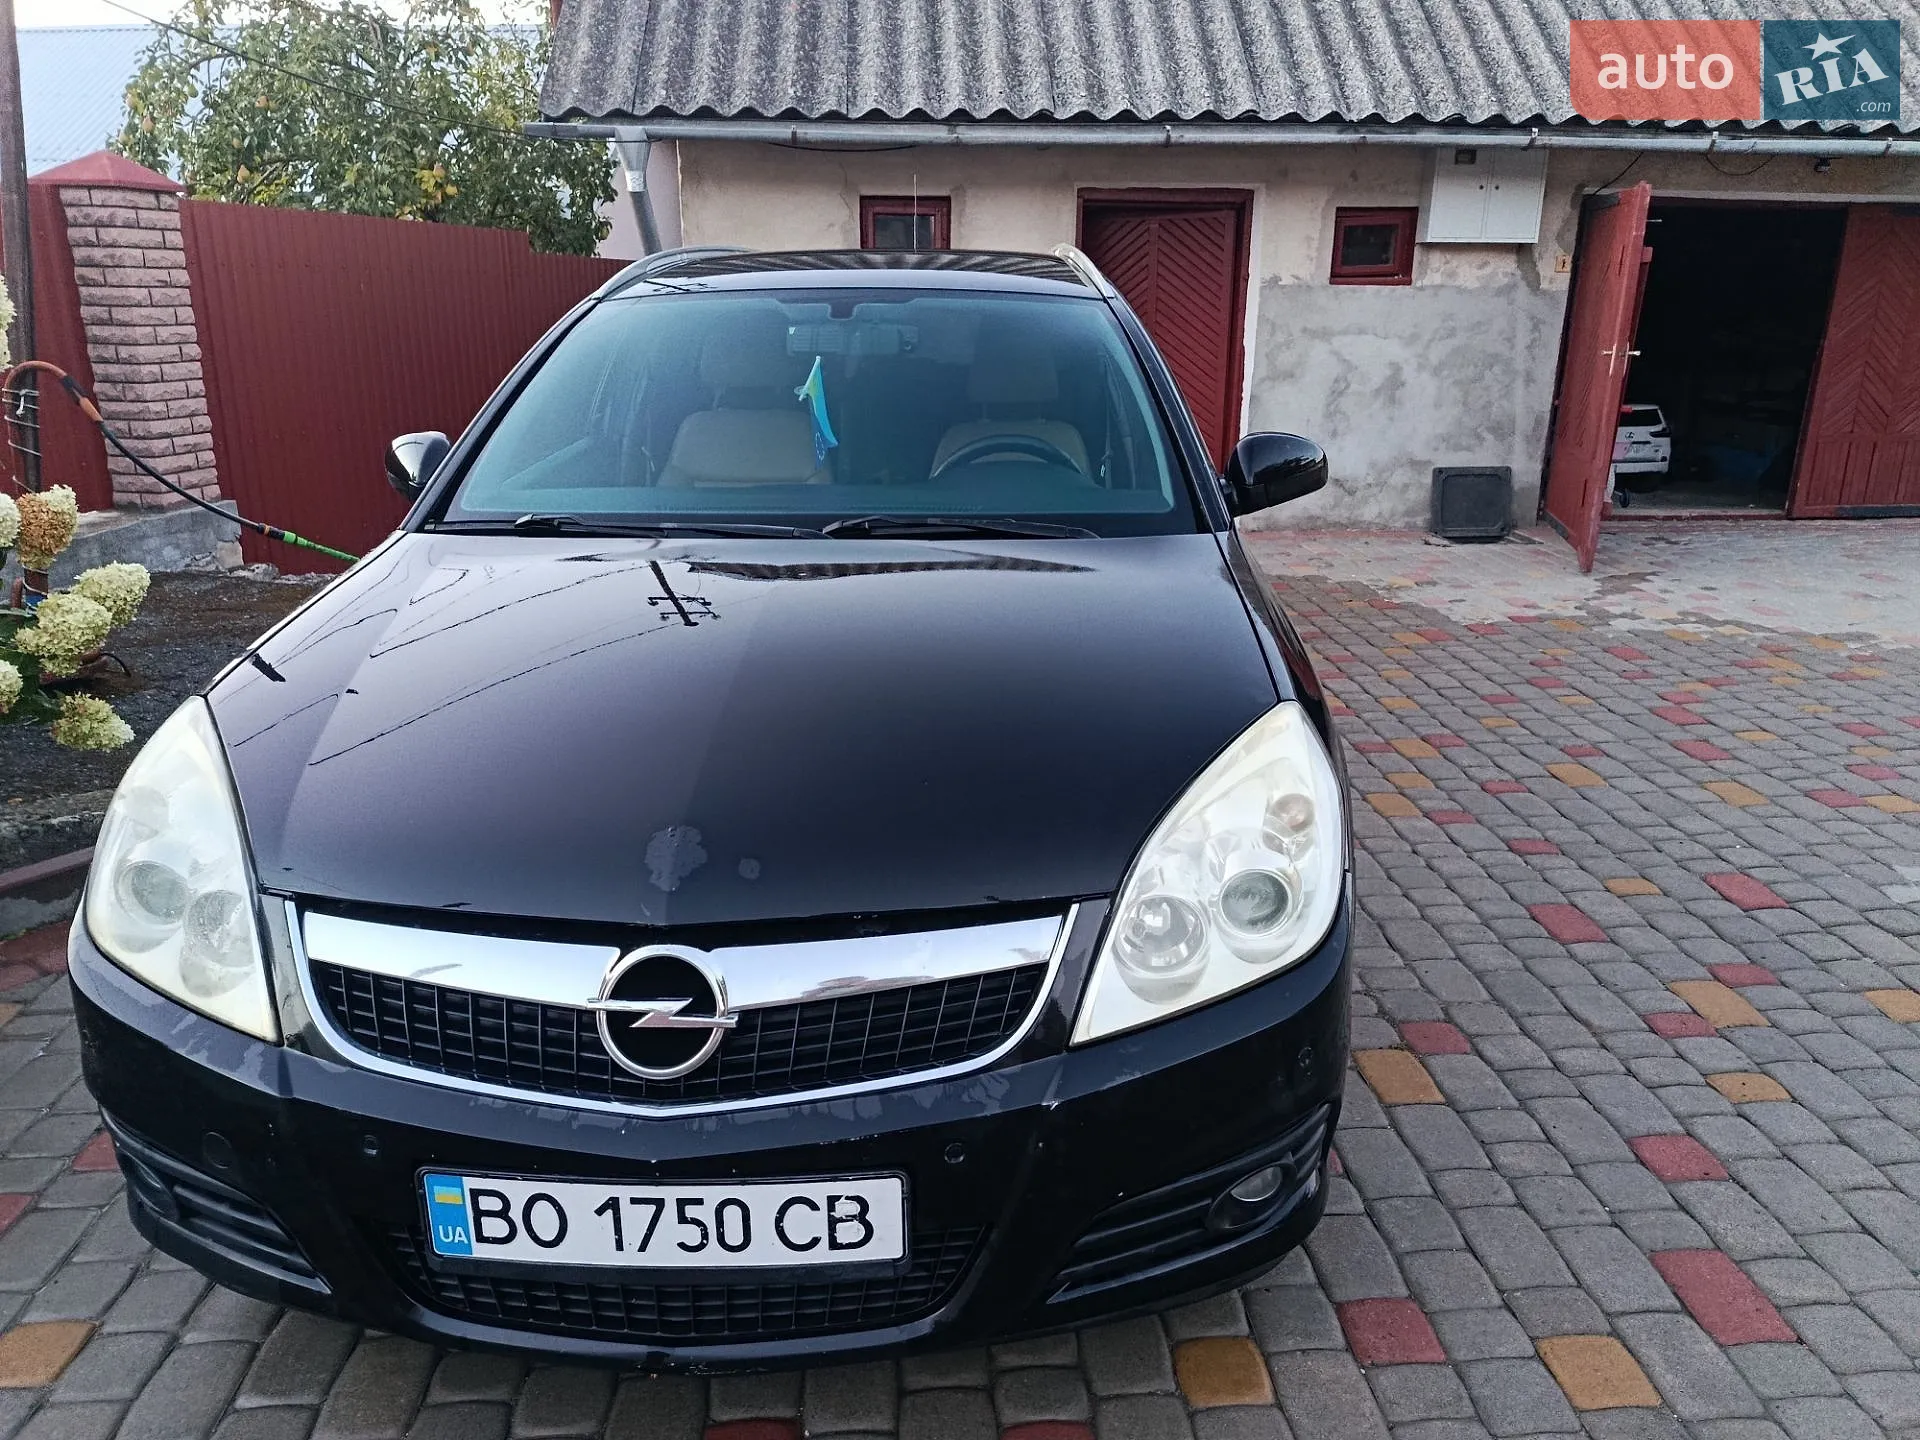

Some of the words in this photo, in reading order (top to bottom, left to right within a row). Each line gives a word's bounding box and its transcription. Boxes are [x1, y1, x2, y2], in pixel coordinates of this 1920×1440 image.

[438, 1224, 468, 1244] UA
[468, 1187, 569, 1249] BO
[594, 1196, 752, 1253] 1750
[774, 1195, 875, 1252] CB
